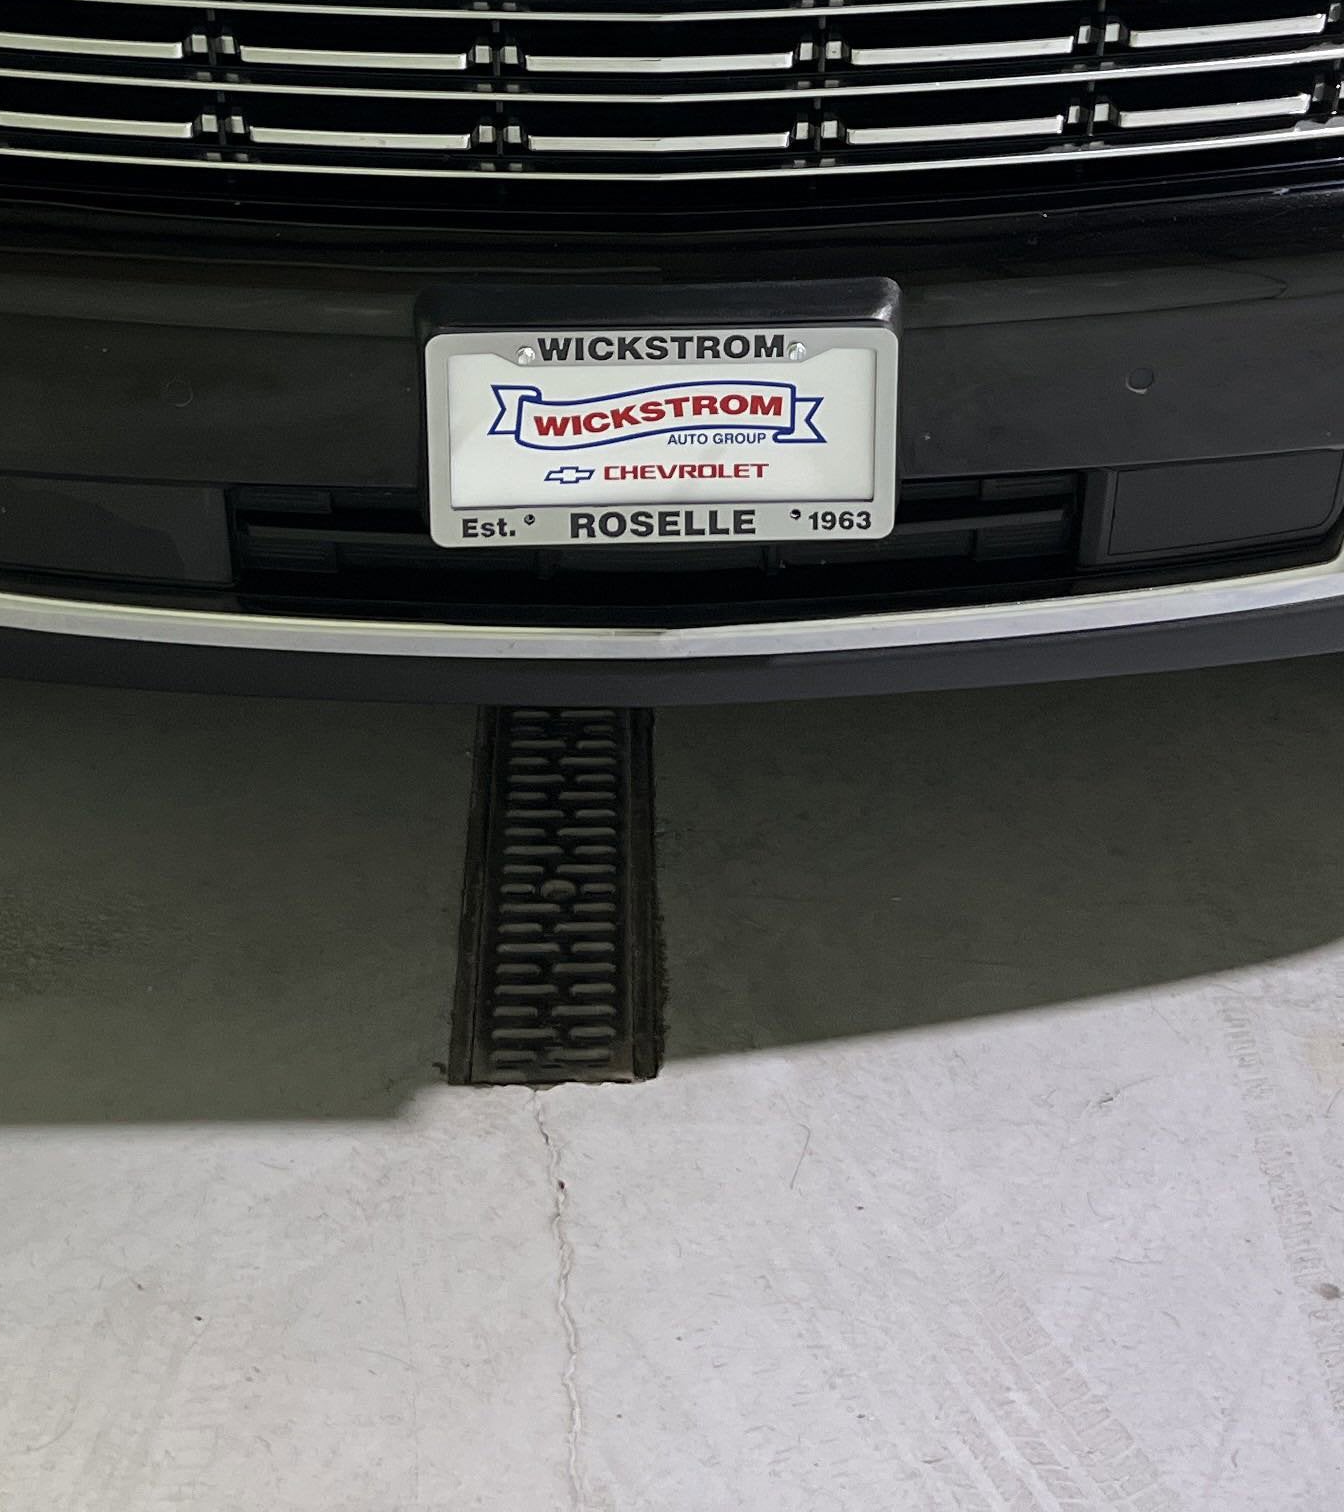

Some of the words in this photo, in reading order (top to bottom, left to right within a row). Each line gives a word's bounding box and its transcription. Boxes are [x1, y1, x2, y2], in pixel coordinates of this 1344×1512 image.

[537, 334, 785, 361] WICKSTROM
[533, 394, 783, 437] WICKSTROM
[667, 433, 708, 445] AUTO
[712, 432, 766, 445] GROUP
[603, 463, 769, 481] CHEVROLET
[461, 517, 516, 538] Est.
[570, 509, 756, 539] ROSELLE
[807, 510, 872, 531] 1963
